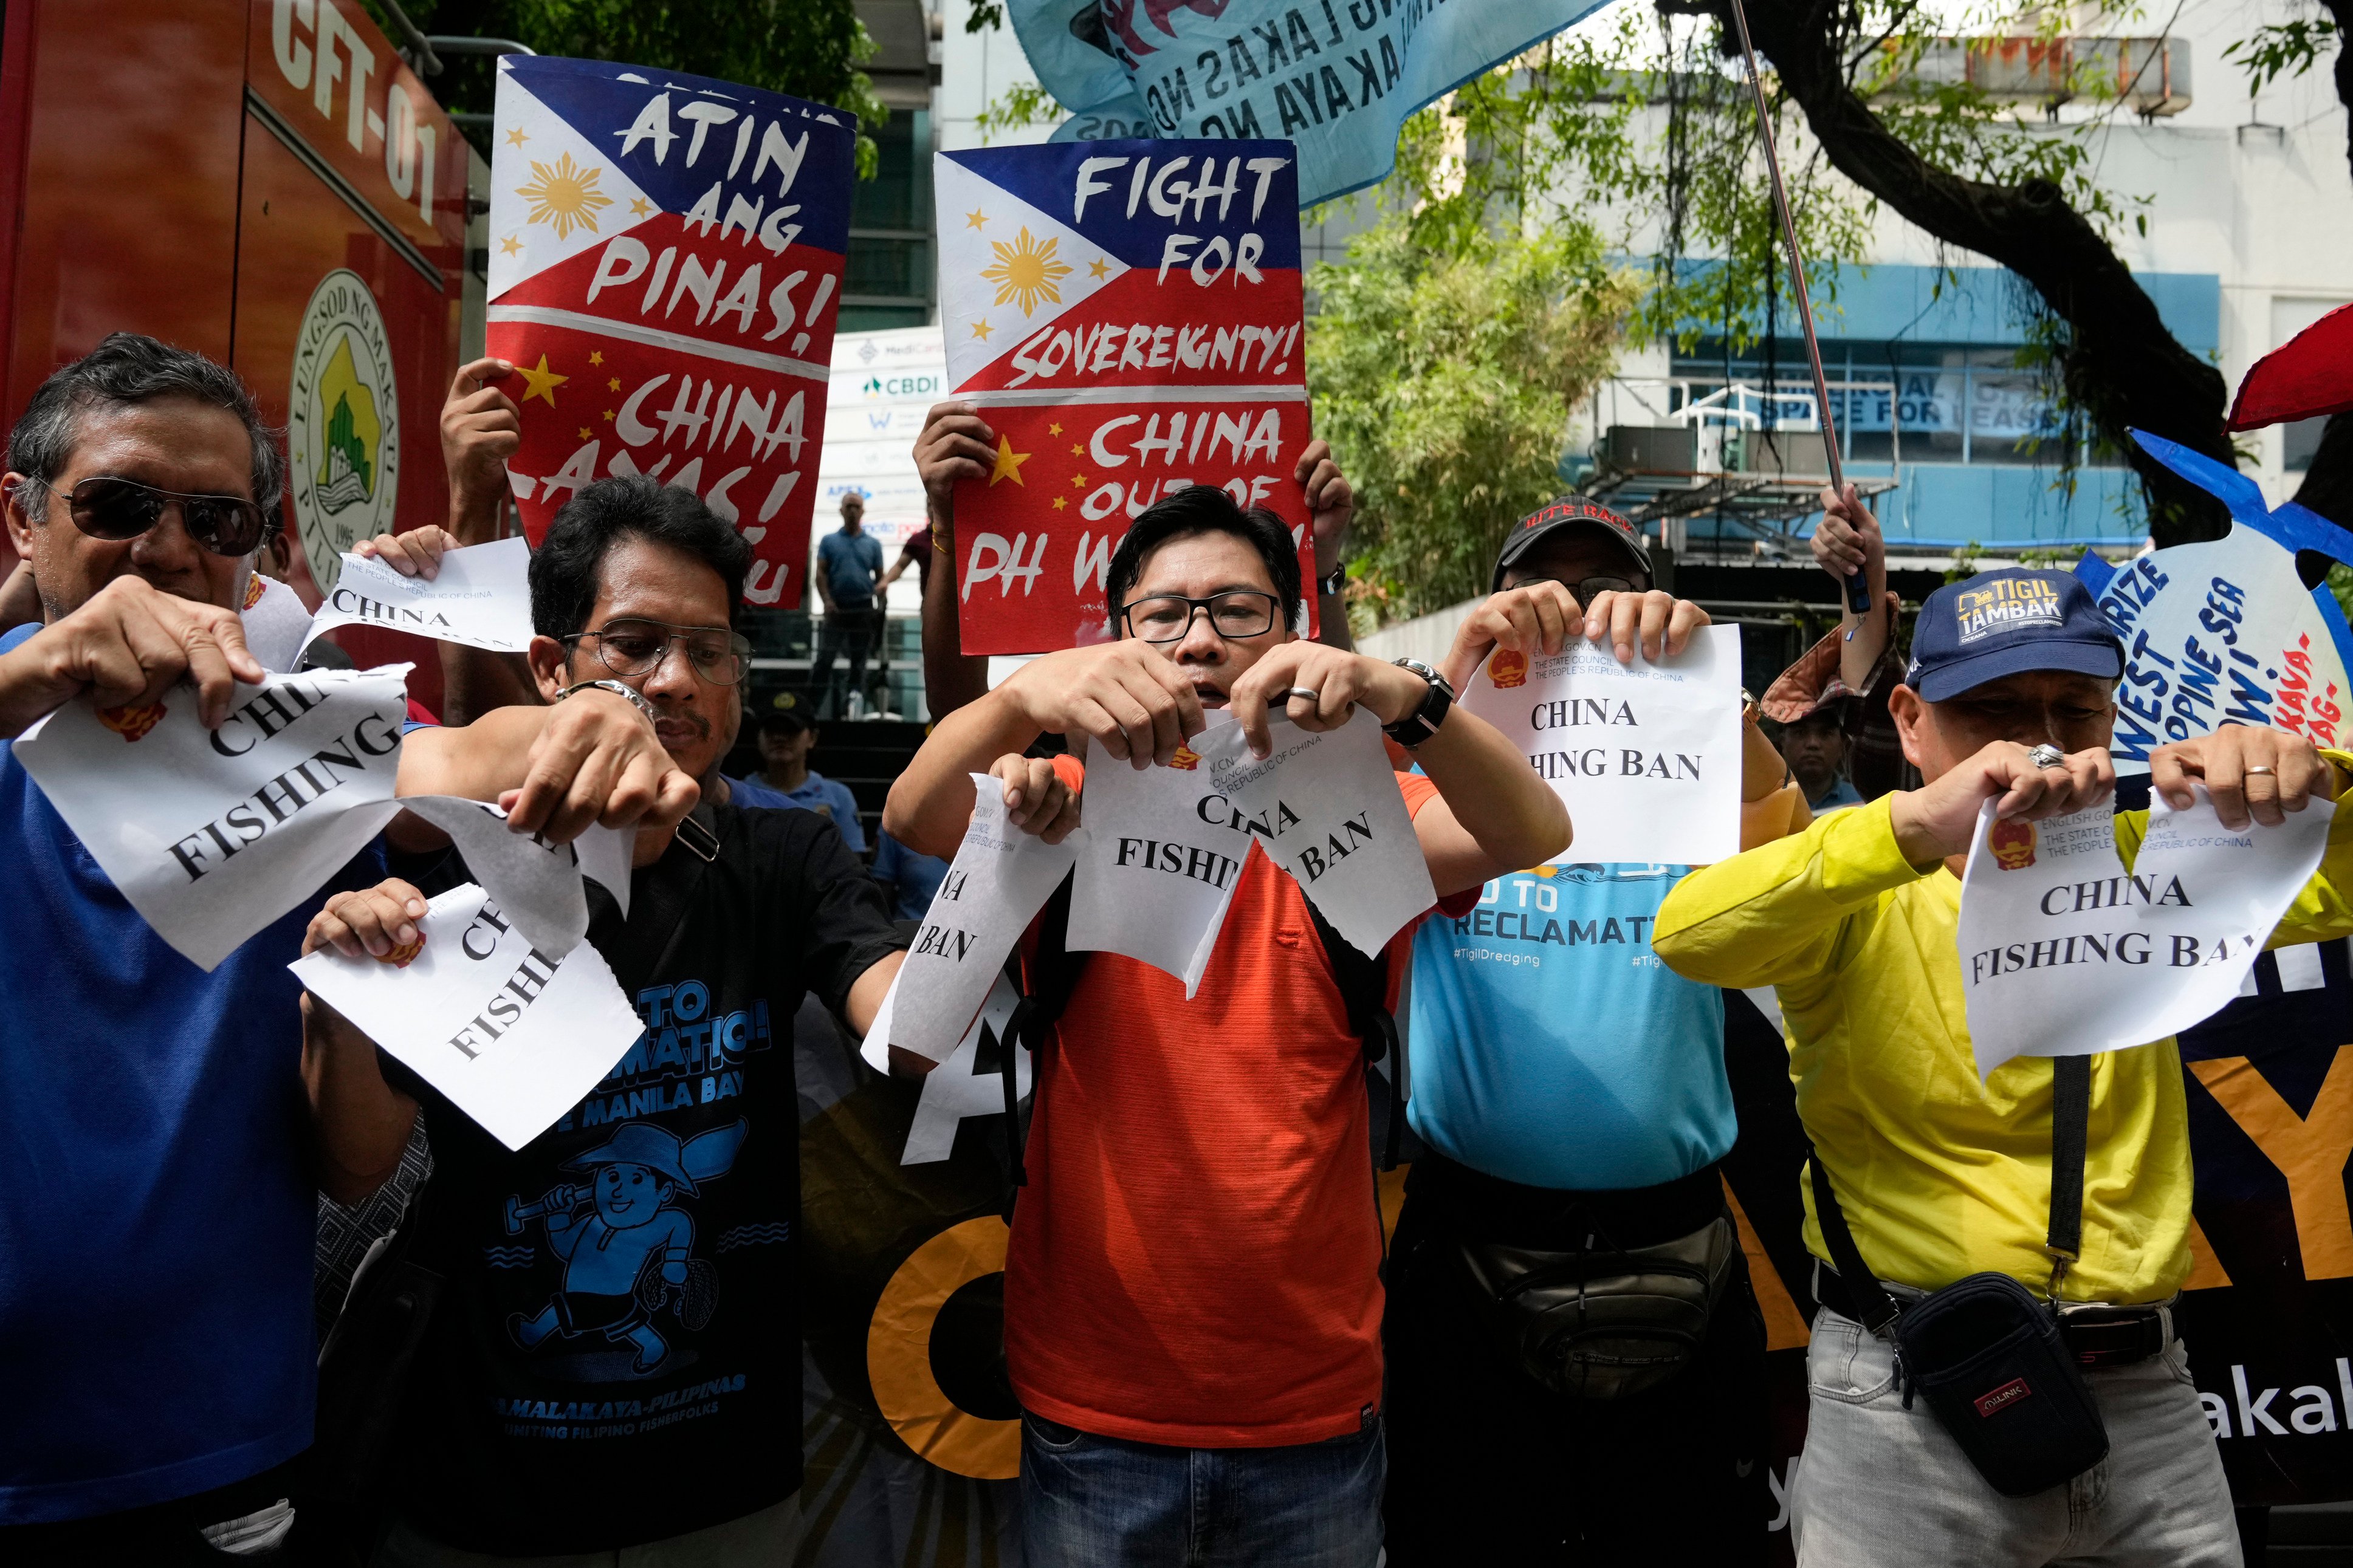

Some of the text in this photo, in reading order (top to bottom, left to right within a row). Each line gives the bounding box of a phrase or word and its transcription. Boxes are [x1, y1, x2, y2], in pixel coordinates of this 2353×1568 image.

[272, 0, 436, 227] CFT-01
[614, 91, 809, 198] ATIN
[1074, 156, 1291, 226] FIGHT
[682, 181, 803, 257] ANG
[1156, 233, 1265, 289] FOR
[586, 235, 837, 357] PINAS!
[886, 377, 938, 395] CBDI
[615, 374, 809, 464] CHINA
[1089, 408, 1283, 468] CHINA
[347, 561, 363, 574] THE
[406, 585, 448, 600] REPUBLIC
[464, 590, 493, 599] CHINA
[961, 532, 1049, 605] PH
[332, 588, 452, 628] CHINA
[1991, 578, 2058, 600] TIGIL
[1958, 597, 2063, 635] TAMBAK
[1961, 631, 1988, 643] OCEANA
[1534, 655, 1615, 670] THE STATE COUNCIL
[1536, 671, 1548, 680] THE
[1548, 666, 1586, 679] PEOPLE'S
[1587, 665, 1636, 678] REPUBLIC
[1652, 673, 1685, 683] CHINA
[2162, 576, 2247, 745] PPINE SEA
[1530, 698, 1640, 732] CHINA
[1210, 763, 1250, 789] OUNCIL
[1228, 759, 1276, 795] REPUBLIC
[1276, 751, 1288, 765] OF
[1289, 735, 1322, 757] CHINA
[1526, 748, 1703, 782] HING BAN
[164, 711, 402, 885] FISHING
[1298, 810, 1373, 885] BAN
[2045, 834, 2066, 846] THE
[2068, 827, 2100, 843] STATE
[2047, 846, 2069, 858] THE
[2146, 838, 2196, 852] REPUBLIC
[2198, 837, 2213, 847] OF
[2215, 837, 2253, 849] CHINA
[1513, 880, 1558, 913] TO
[2040, 873, 2194, 917] CHINA
[915, 925, 978, 964] BAN
[1454, 910, 1655, 947] RECLAMAT
[1454, 947, 1541, 968] #TigilDredging
[1971, 932, 2152, 988] FISHING
[445, 945, 567, 1063] FISHI
[639, 979, 709, 1029] TO
[582, 1083, 694, 1129] MANILA
[701, 1069, 745, 1104] BAY
[504, 1401, 720, 1440] UNITING FILIPINO FISHERFOLKS
